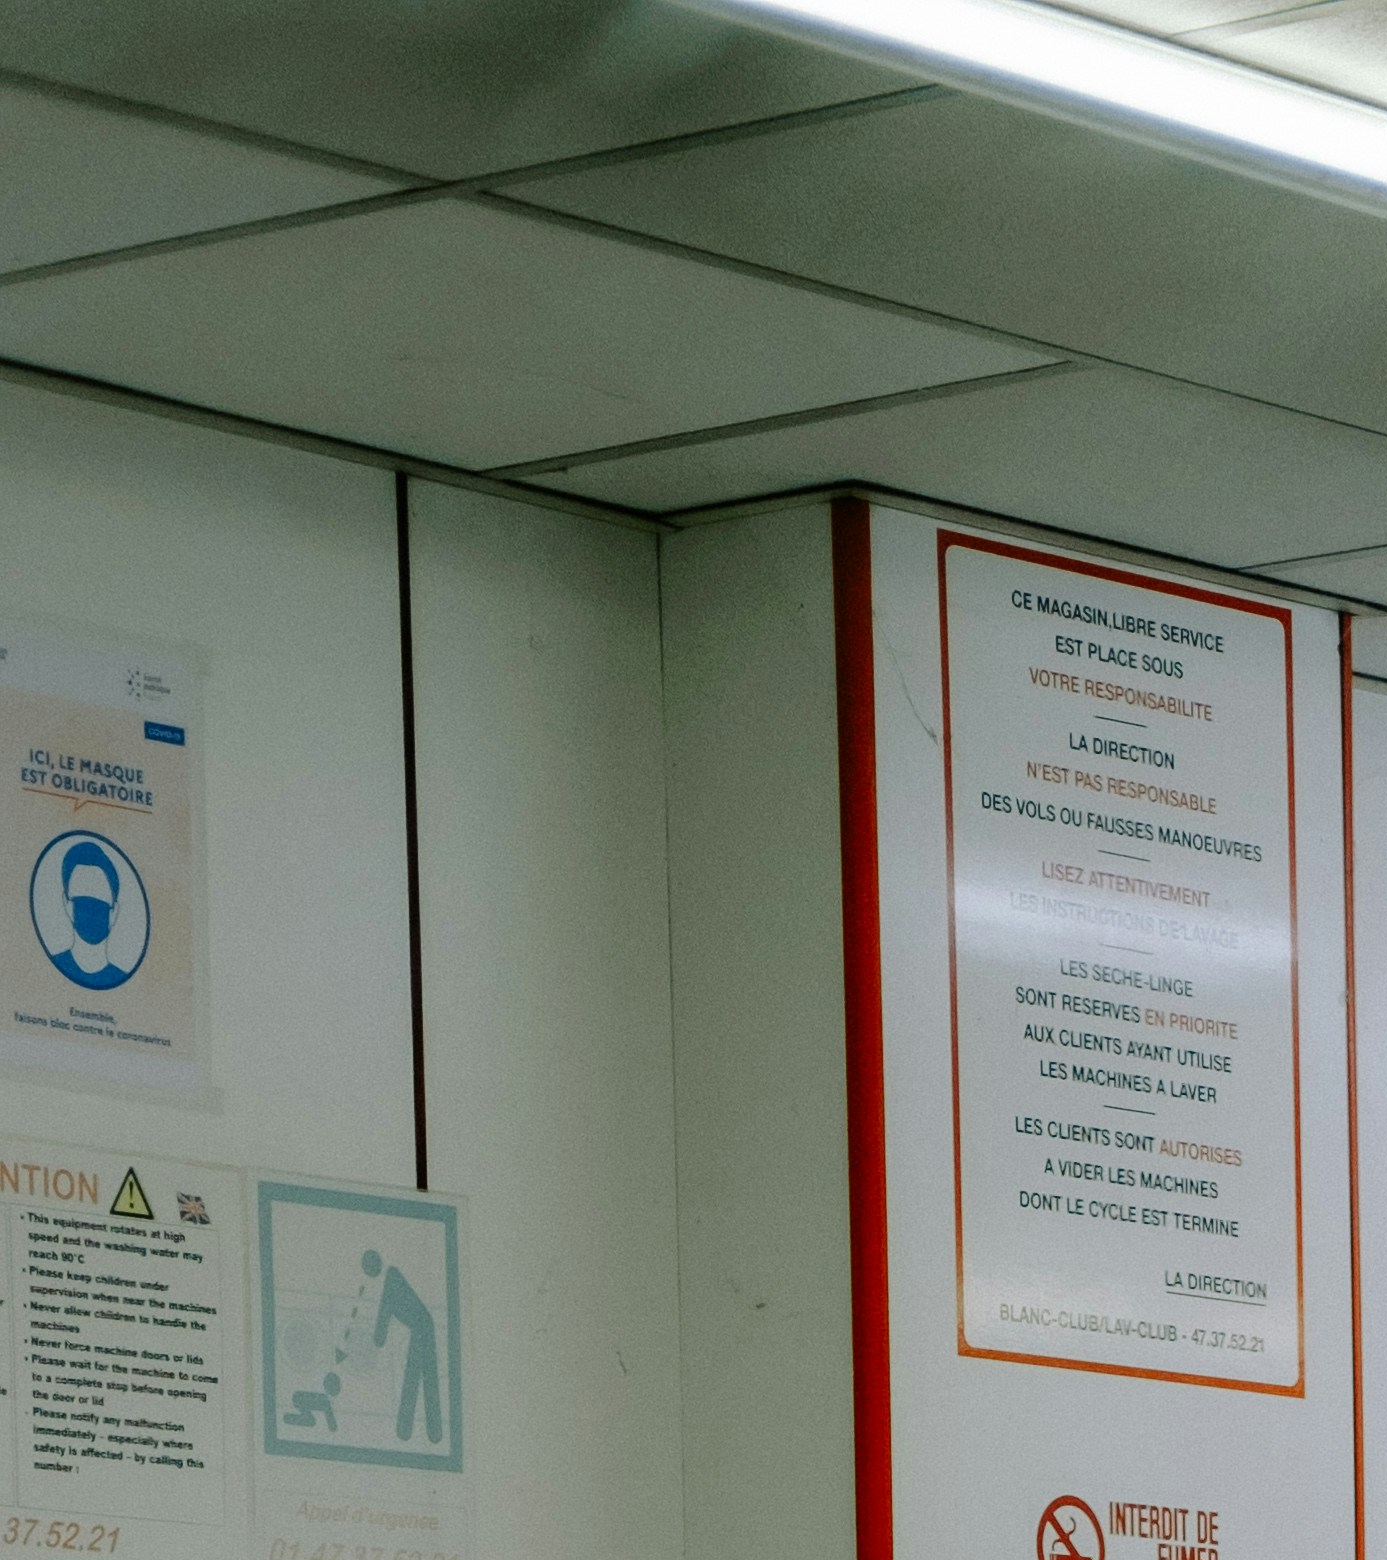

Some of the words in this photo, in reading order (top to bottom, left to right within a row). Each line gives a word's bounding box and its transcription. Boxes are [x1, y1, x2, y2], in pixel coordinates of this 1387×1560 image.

[1011, 590, 1033, 611] CE
[1160, 622, 1224, 653] SERVICE
[1055, 636, 1083, 656] EST
[1088, 644, 1137, 669] PLACE
[1142, 656, 1184, 679] SOUS
[1029, 667, 1079, 693] VOTRE
[1085, 679, 1213, 721] RESPONSABILITE
[30, 748, 54, 770] ICI,
[59, 754, 75, 771] LE
[80, 759, 144, 784] MASQUE
[1069, 732, 1088, 752] LA
[1093, 738, 1175, 770] DIRECTION
[21, 767, 47, 785] EST
[52, 774, 153, 806] OBLIGATOIRE
[1026, 761, 1070, 785] N'EST
[1075, 770, 1103, 792] PAS
[1107, 777, 1217, 815] RESPONSABLE
[981, 792, 1012, 814] DES
[1016, 800, 1056, 822] VOLS
[1060, 808, 1082, 827] OU
[1086, 813, 1154, 841] FAUSSES
[1158, 827, 1262, 863] MANOEUVRES
[1023, 1024, 1055, 1044] AUX
[1059, 1030, 1122, 1055] CLIENTS
[1126, 1040, 1172, 1062] AYANT
[1177, 1048, 1232, 1074] UTILISE
[1040, 1060, 1068, 1080] LES
[1072, 1066, 1152, 1094] MACHINES
[1156, 1079, 1166, 1095] A
[1170, 1083, 1217, 1103] LAVER
[1108, 1502, 1189, 1543] INTERDIT
[1197, 1513, 1220, 1546] DE
